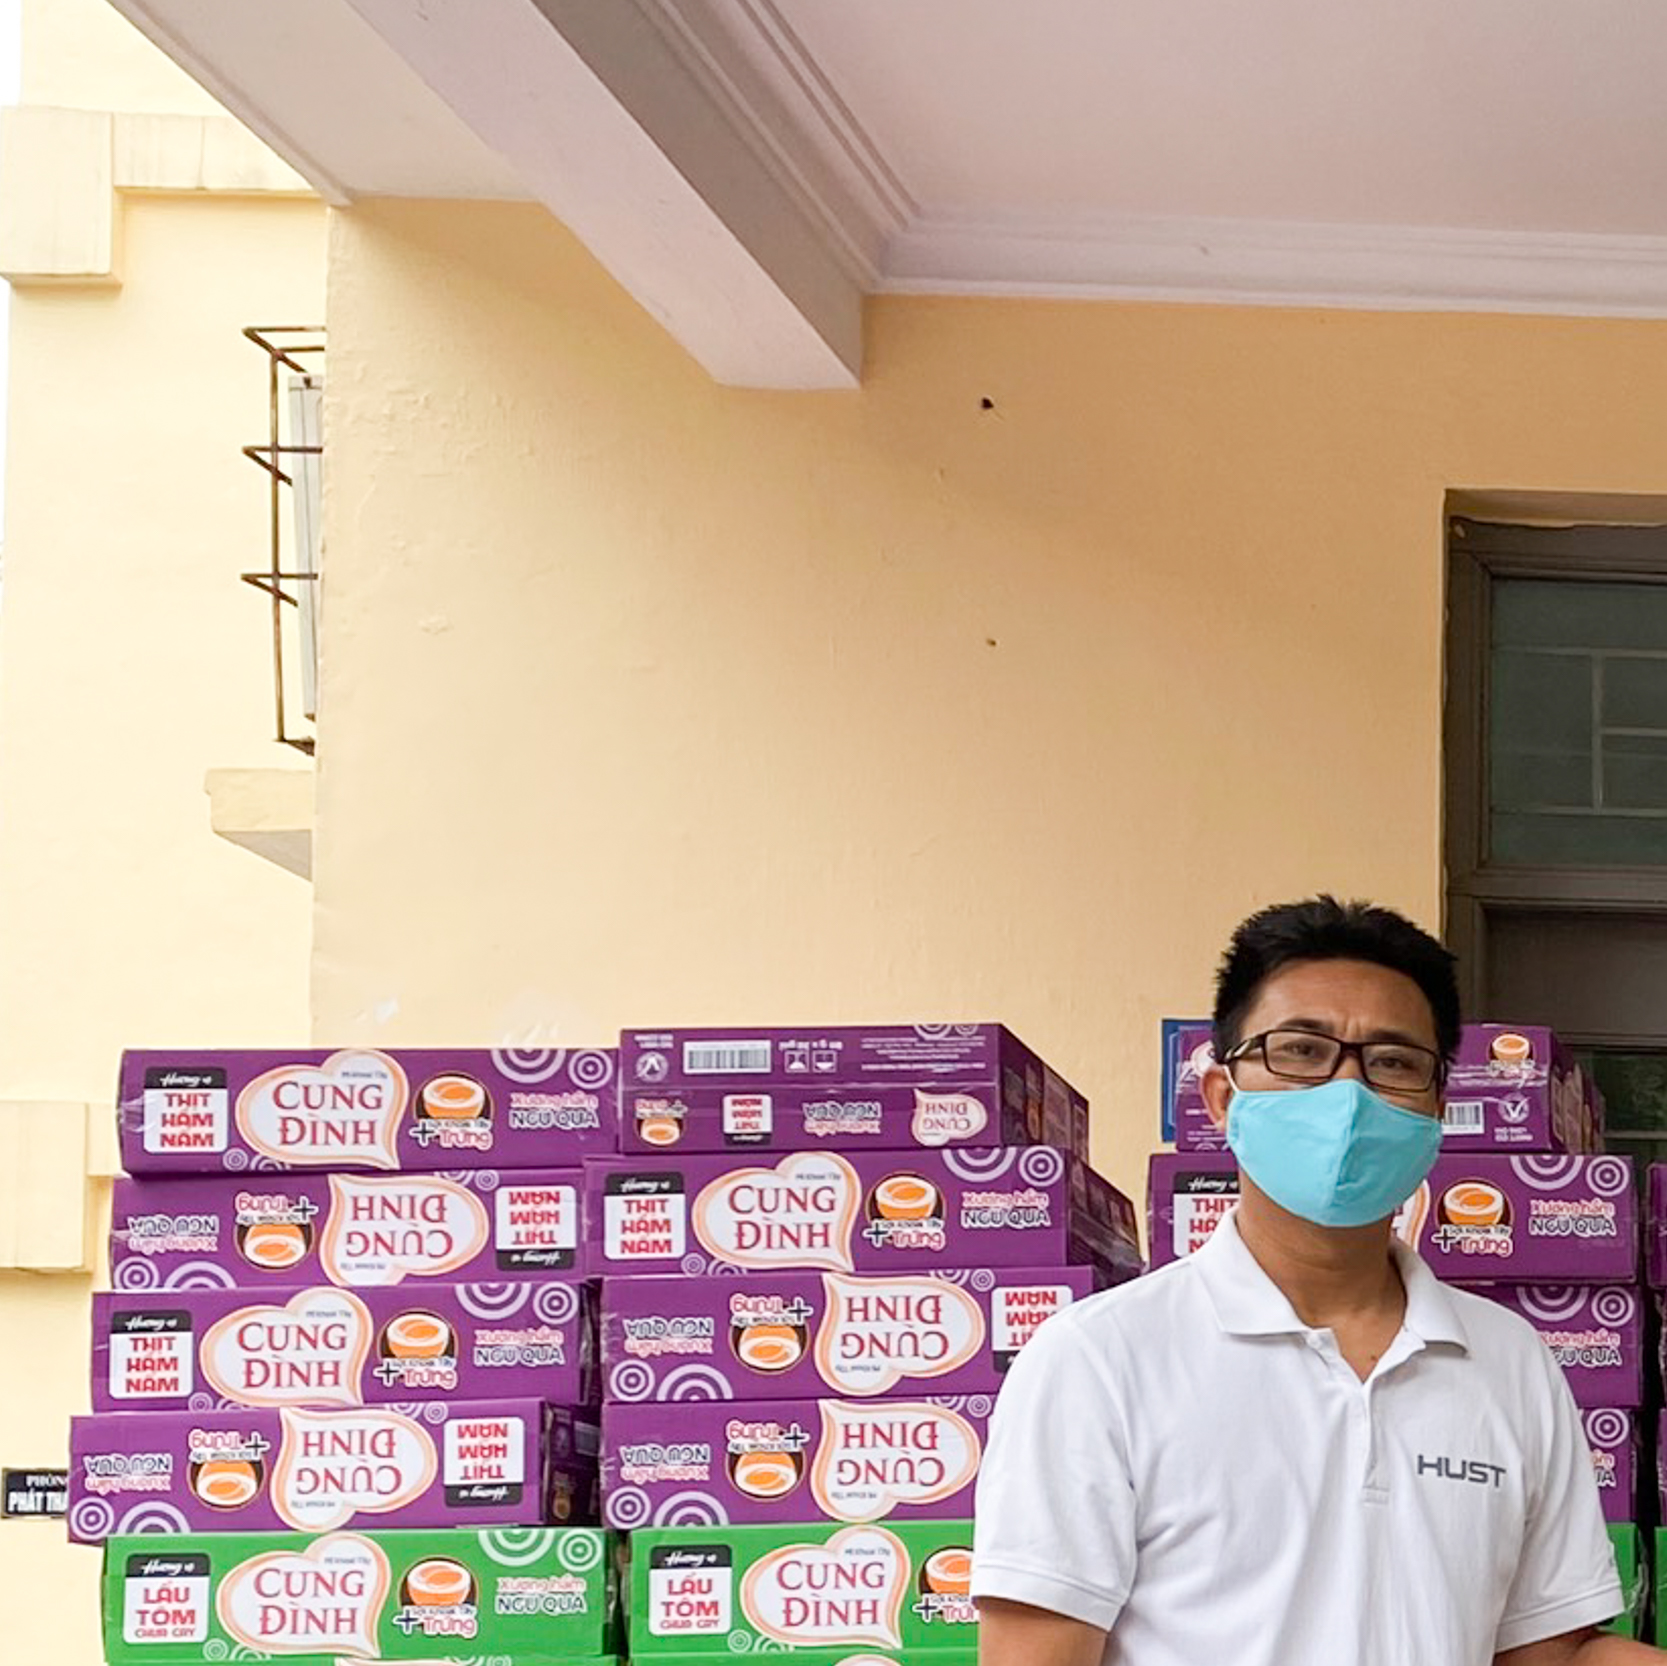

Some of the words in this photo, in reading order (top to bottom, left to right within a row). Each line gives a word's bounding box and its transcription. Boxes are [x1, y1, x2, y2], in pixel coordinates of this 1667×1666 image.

[272, 1081, 383, 1112] CUNG
[278, 1112, 377, 1146] ĐÌNH
[728, 1184, 837, 1214] CUNG
[347, 1230, 453, 1258] CUNG
[735, 1215, 830, 1249] ĐÌNH
[237, 1322, 348, 1353] CUNG
[243, 1353, 341, 1387] ĐÌNH
[1417, 1454, 1506, 1488] HUST
[254, 1569, 365, 1598] CUNG
[776, 1560, 885, 1591] CUNG
[138, 1607, 196, 1626] TÔM
[259, 1599, 357, 1636] ĐÌNH
[783, 1591, 879, 1626] ĐÌNH
